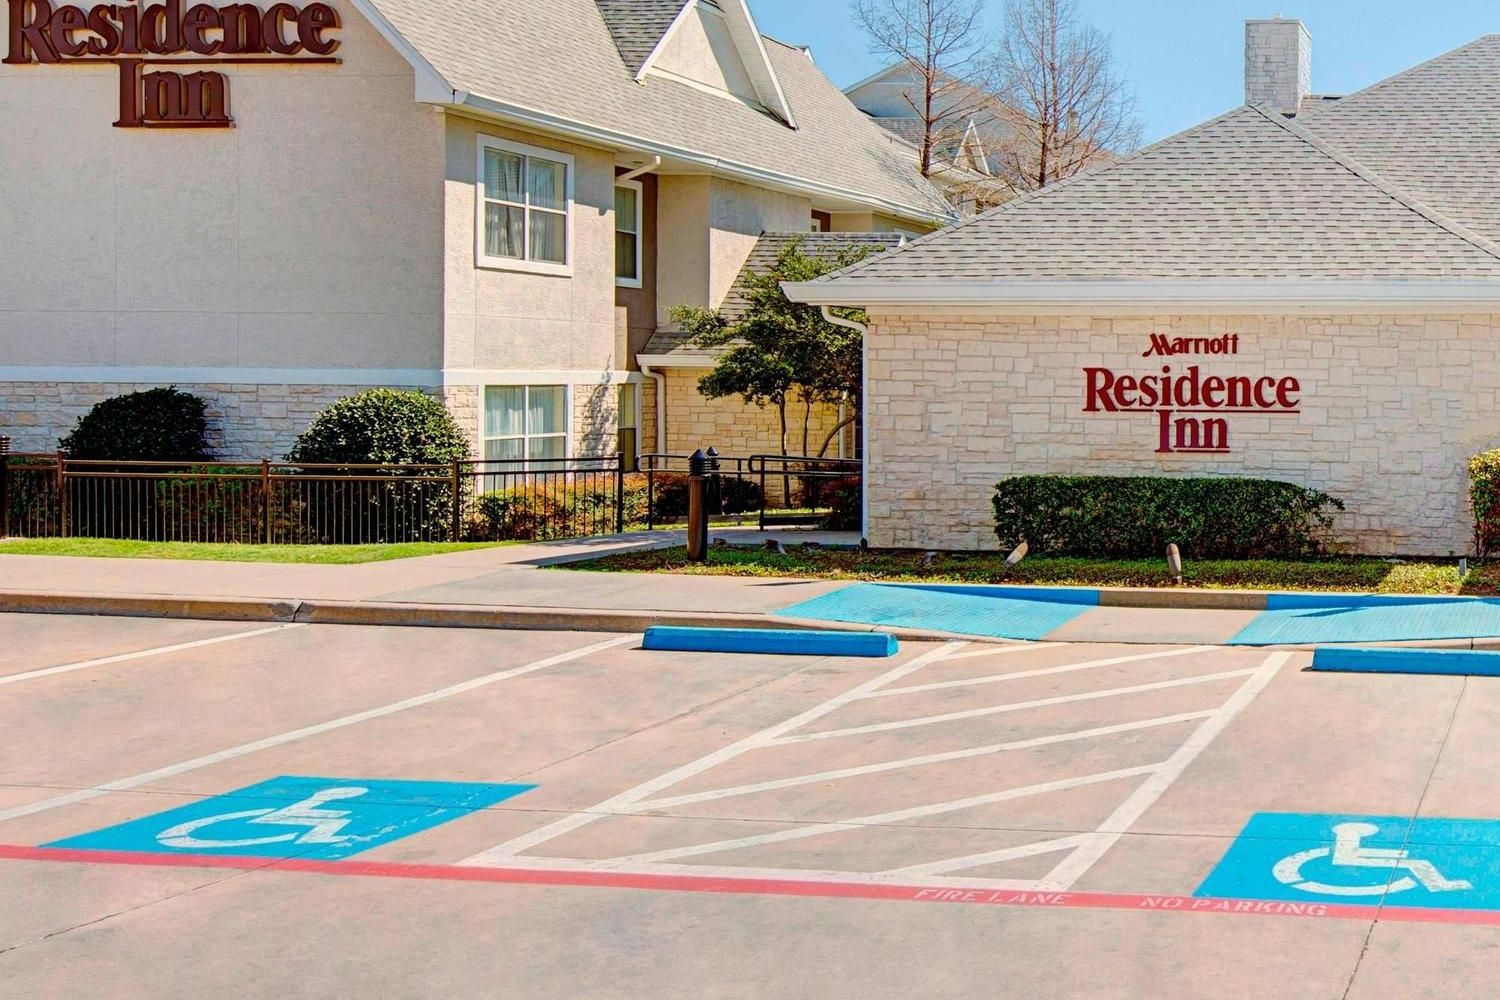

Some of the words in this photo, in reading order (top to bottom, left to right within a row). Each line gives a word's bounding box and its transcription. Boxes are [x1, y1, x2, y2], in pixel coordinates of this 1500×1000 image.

[112, 58, 236, 127] Inn
[1142, 333, 1239, 357] Marriott
[1082, 365, 1299, 412] Residence
[1154, 409, 1230, 453] Inn
[914, 888, 984, 901] FIRE
[988, 891, 1073, 905] LANE
[1139, 897, 1184, 909] NO
[1191, 899, 1328, 916] PARKING
